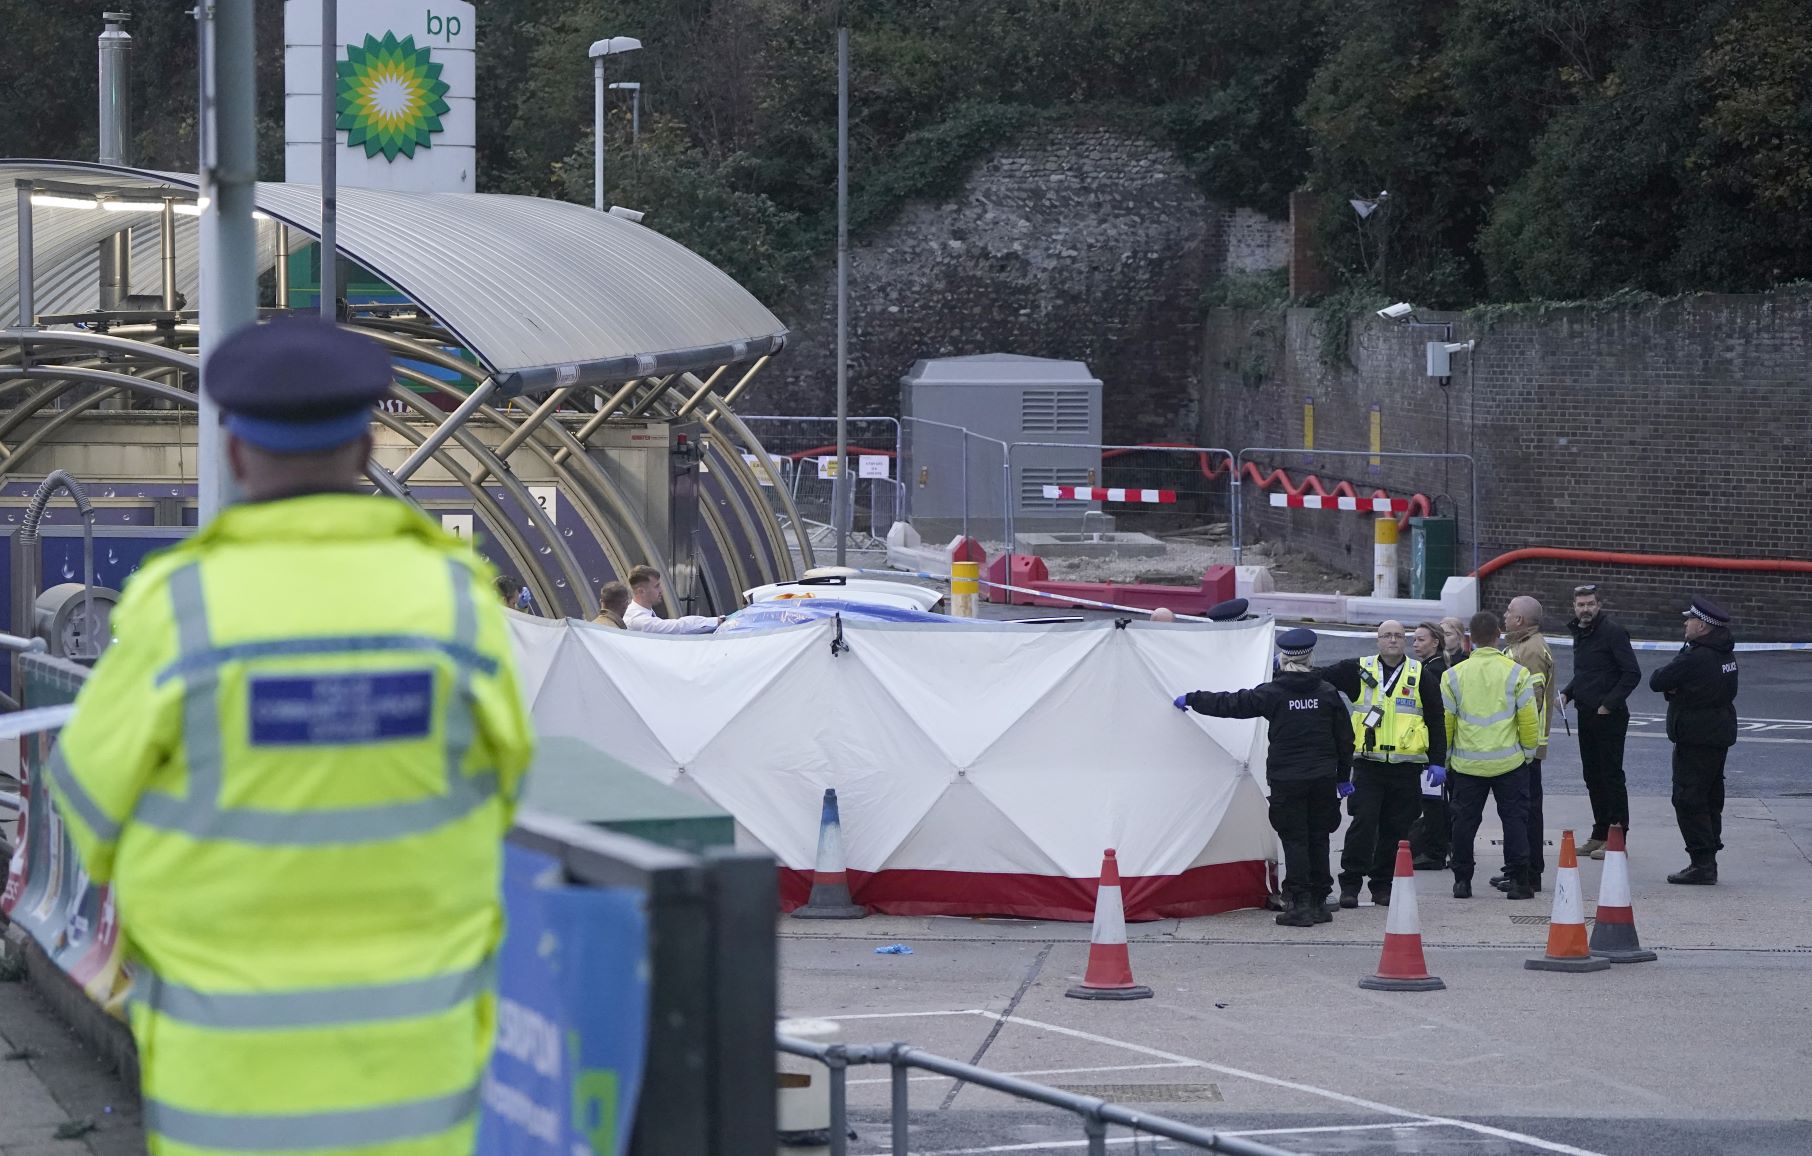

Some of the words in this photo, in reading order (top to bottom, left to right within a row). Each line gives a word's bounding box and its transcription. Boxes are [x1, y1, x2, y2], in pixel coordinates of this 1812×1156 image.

[427, 9, 461, 42] bp
[537, 496, 547, 510] 2
[1721, 661, 1737, 674] POLICE
[1288, 698, 1319, 711] POLICE
[1396, 698, 1416, 707] POLICE
